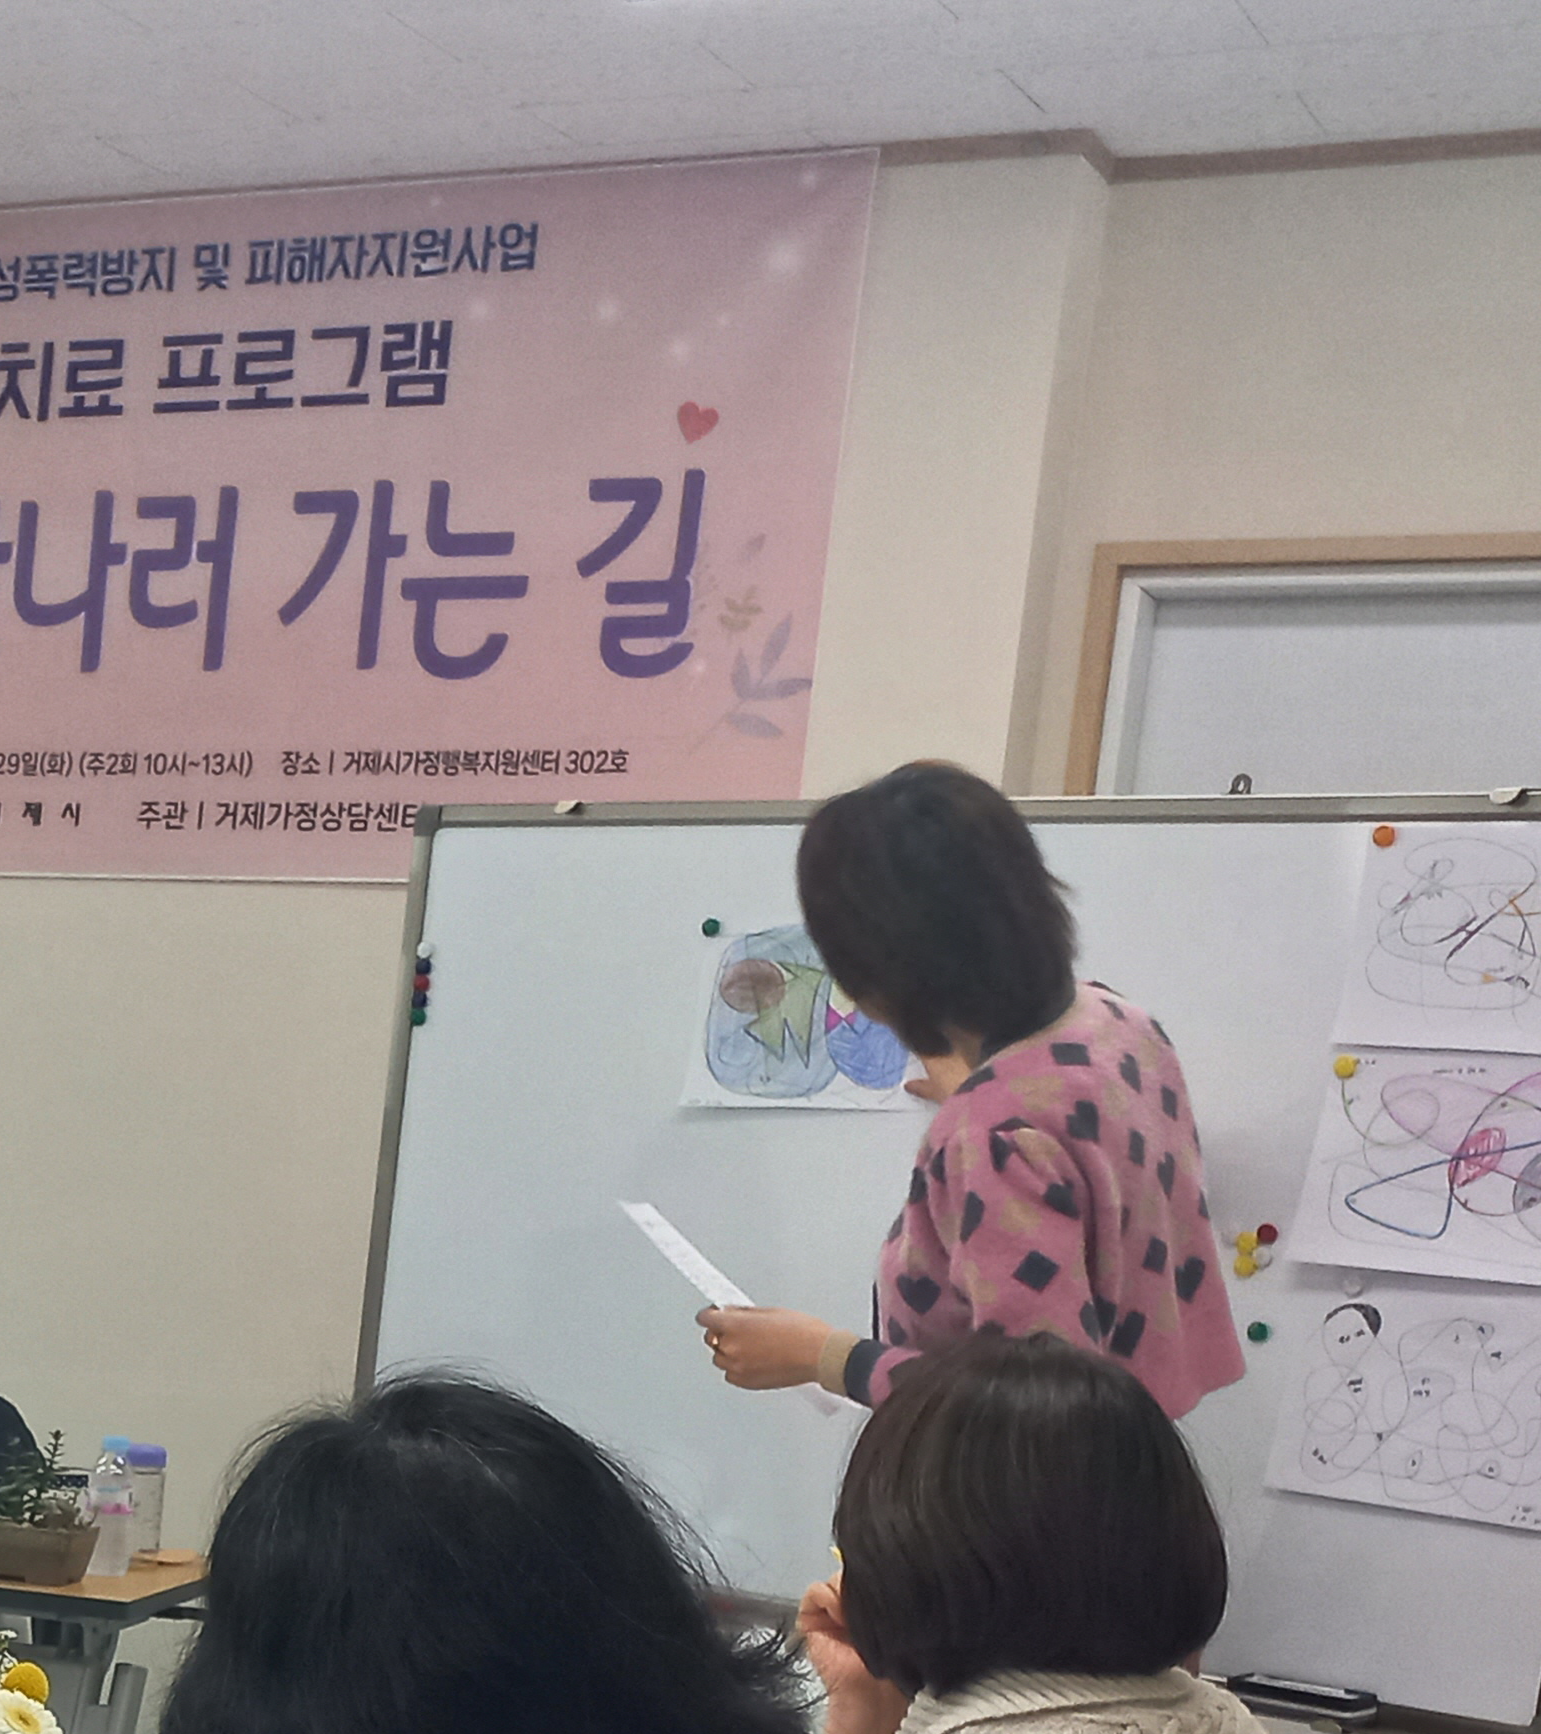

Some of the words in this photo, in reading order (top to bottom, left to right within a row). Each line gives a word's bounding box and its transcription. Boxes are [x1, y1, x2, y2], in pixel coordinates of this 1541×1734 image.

[193, 242, 231, 291] 및
[244, 222, 539, 285] 피해자지원사업
[153, 320, 453, 414] 프로그램
[277, 479, 529, 680] 가는
[576, 468, 706, 679] 길
[78, 751, 138, 777] (주2회
[281, 750, 322, 777] 장소
[563, 749, 630, 775] 302호
[136, 800, 189, 831] 주관
